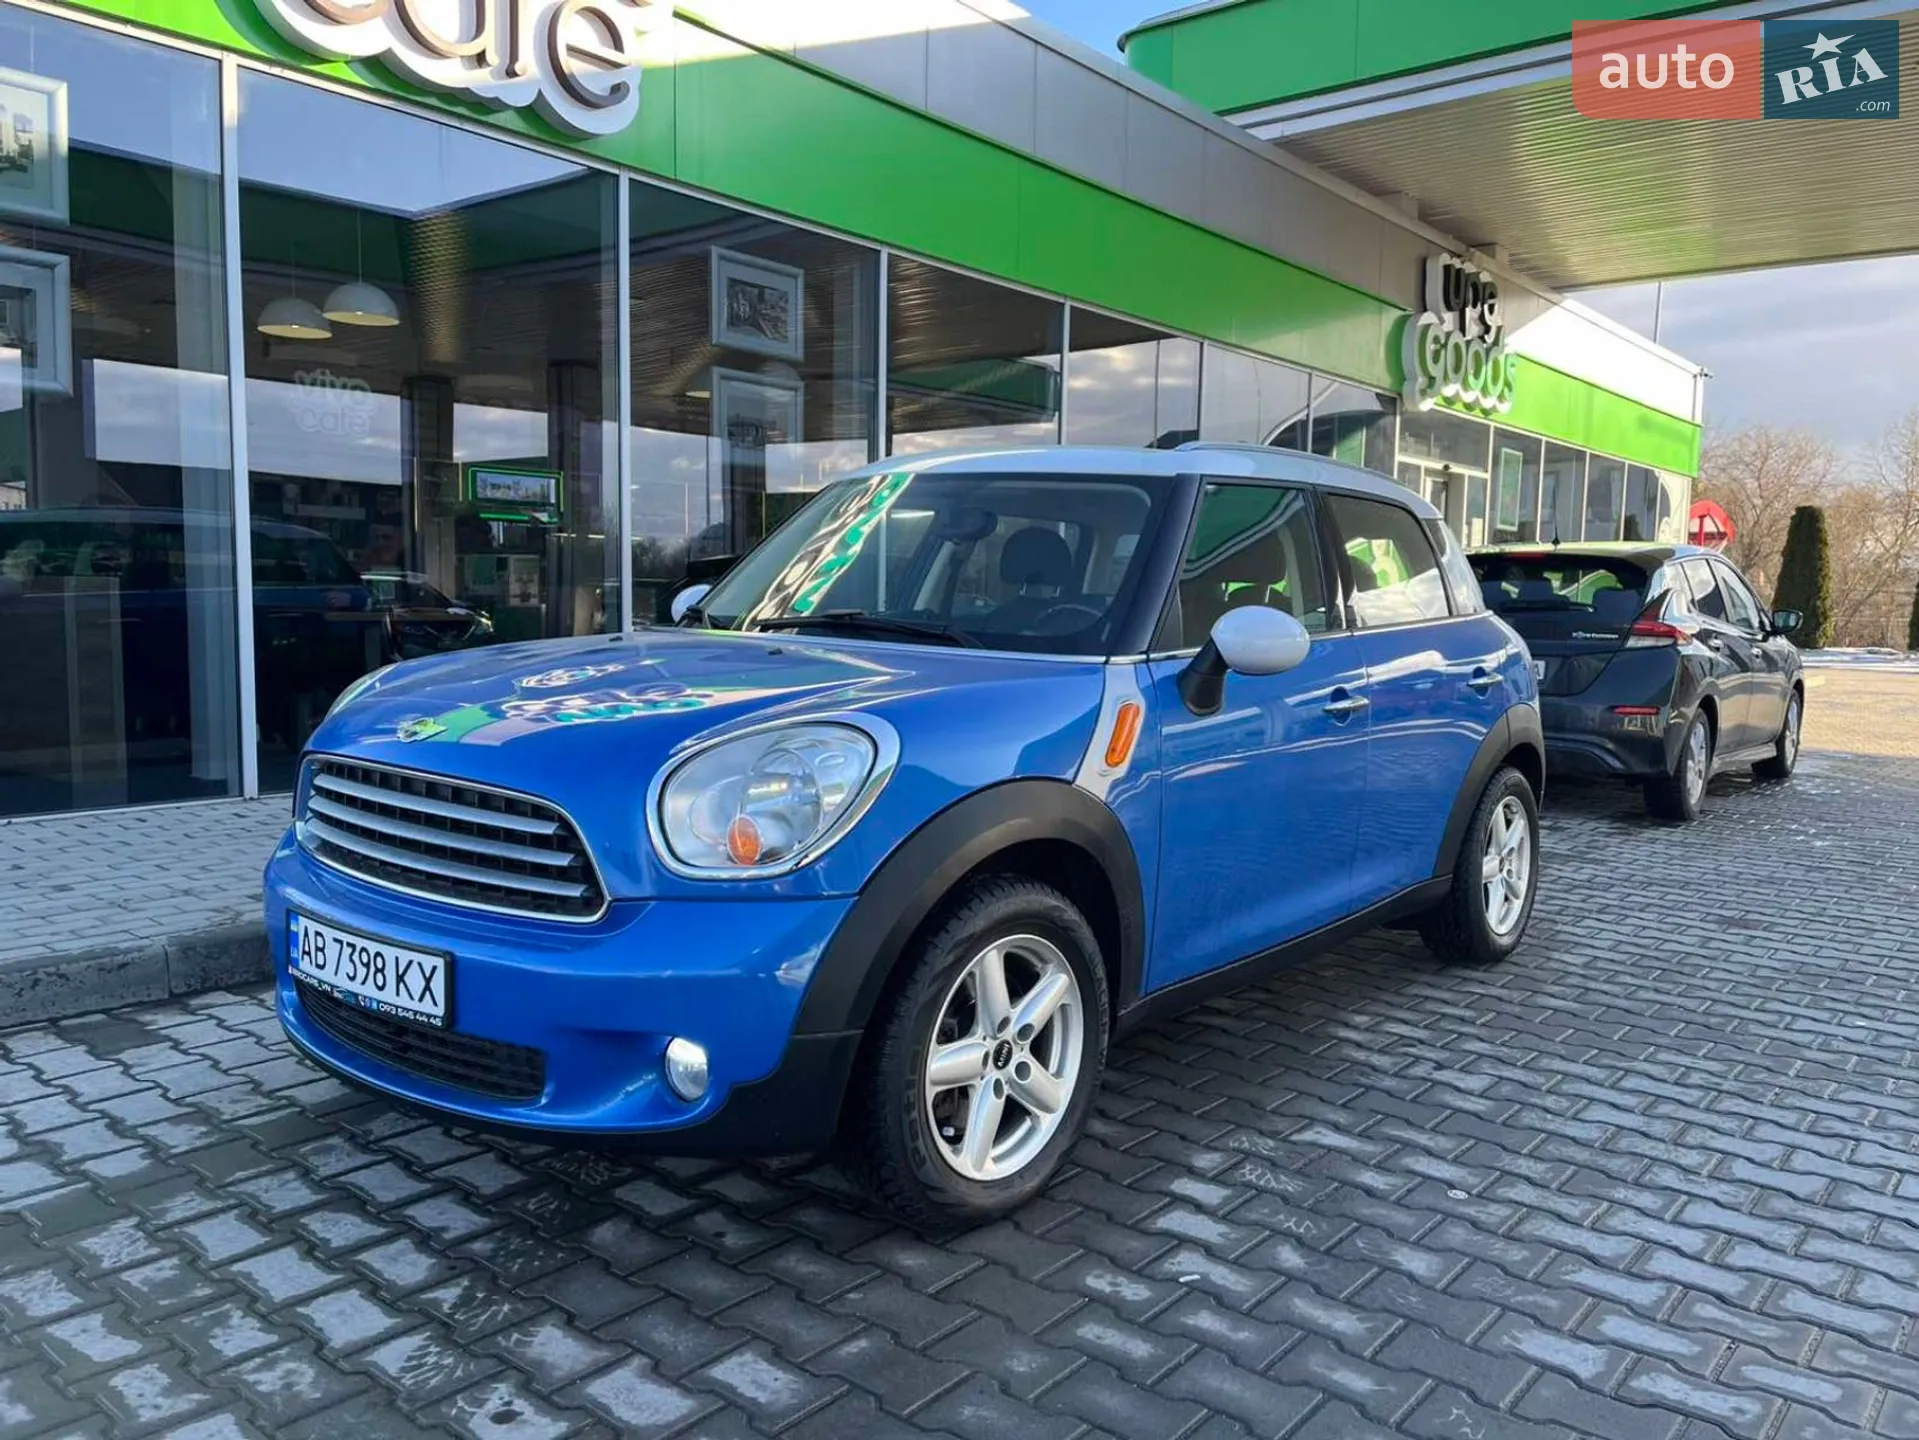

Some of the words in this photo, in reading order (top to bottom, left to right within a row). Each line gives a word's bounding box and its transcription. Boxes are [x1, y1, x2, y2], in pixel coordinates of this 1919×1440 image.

[301, 925, 327, 970] AB
[332, 937, 387, 991] 7398
[395, 956, 438, 1007] KX
